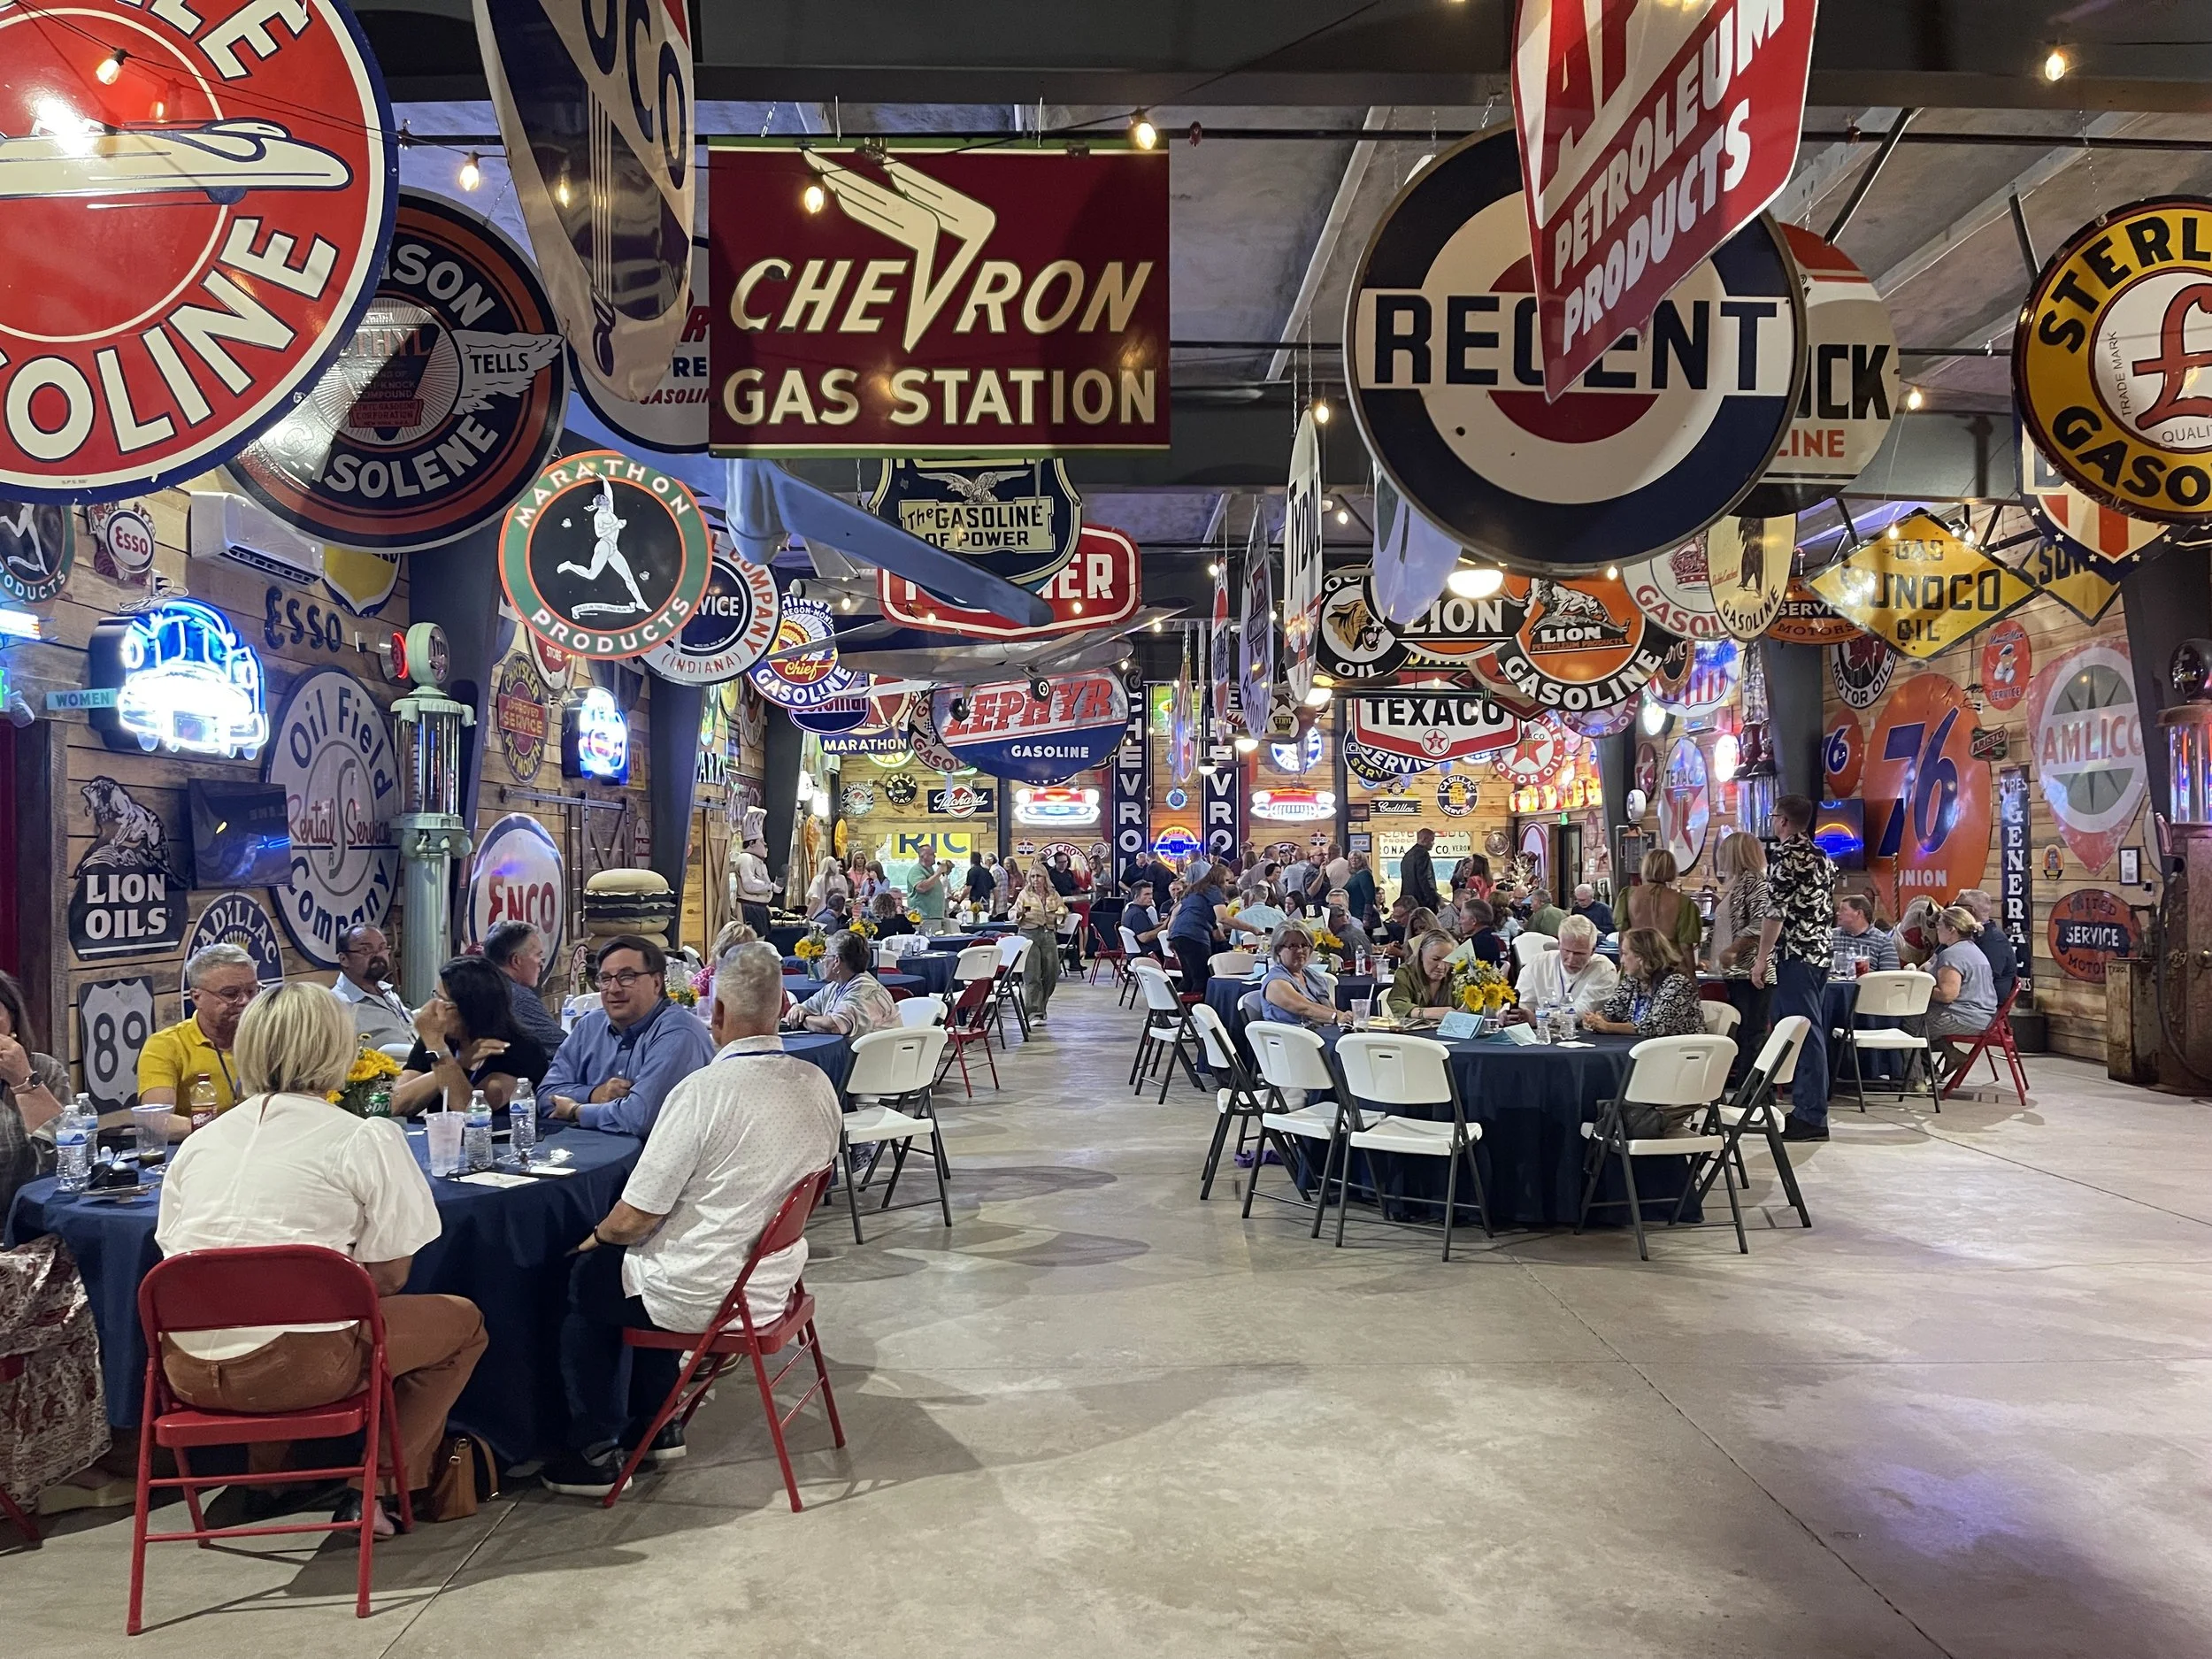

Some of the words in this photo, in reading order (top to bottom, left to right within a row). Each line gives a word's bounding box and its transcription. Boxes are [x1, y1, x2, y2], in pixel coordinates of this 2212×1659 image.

[1555, 0, 1786, 288] PETROLEUM
[1563, 99, 1750, 356] PRODUCTS
[730, 221, 1153, 354] CHEVRON
[2039, 218, 2212, 354] STERL
[0, 218, 337, 462] OLINE
[339, 328, 433, 356] THYL
[2107, 331, 2124, 370] MARK
[470, 352, 529, 373] TELLS
[723, 367, 861, 426] GAS
[889, 367, 1156, 426] STATION
[2116, 372, 2131, 417] TRADE
[513, 457, 691, 530] MARATHON
[907, 508, 934, 531] The
[935, 505, 1043, 529] GASOLINE
[115, 526, 149, 555] ESSO
[925, 532, 950, 547] OF
[956, 531, 1029, 547] POWER
[1288, 471, 1321, 601] TYDOL
[1895, 539, 1945, 562] GAS
[265, 586, 342, 653] ESSO
[1722, 585, 1780, 632] GASOLINE
[531, 597, 691, 654] PRODUCTS
[1541, 626, 1601, 641] LION
[1779, 622, 1856, 637] MOTORS
[1897, 618, 1941, 641] OIL
[546, 644, 563, 663] STORE
[1532, 640, 1579, 650] PETROLEUM
[1581, 637, 1624, 647] PRODUCTS
[661, 651, 742, 675] (INDIANA)
[784, 660, 819, 680] Chief
[1335, 663, 1384, 679] OIL
[504, 660, 541, 701] CHRYSLER
[756, 665, 852, 705] GASOLINE
[1504, 648, 1663, 710] GASOLINE
[1833, 663, 1868, 707] MOTOR
[56, 693, 111, 710] WOMEN
[1991, 687, 2022, 701] SERVICE
[503, 710, 543, 734] SERVICE
[1366, 698, 1504, 726] TEXACO
[1617, 696, 1640, 726] OIL
[290, 687, 327, 769] Oil
[339, 686, 394, 800] Field
[824, 738, 907, 752] MARATHON
[1010, 744, 1089, 758] GASOLINE
[1972, 730, 2004, 752] ARISTO
[505, 736, 541, 778] PLYMOUTH
[697, 752, 727, 786] ARKS
[1492, 752, 1540, 785] MOTOR
[1544, 750, 1564, 777] OIL
[887, 772, 917, 788] POLLY
[1440, 775, 1475, 792] CADILLAC
[1878, 706, 1960, 859] 76
[2001, 777, 2028, 792] TIRES
[933, 791, 989, 811] Packard
[1378, 801, 1416, 813] Cadillac
[1444, 804, 1471, 816] SERVICE
[288, 794, 338, 847] Rental
[345, 797, 393, 846] Service
[1380, 845, 1407, 855] ONA
[1435, 845, 1450, 855] CO.
[86, 873, 167, 904] LION
[488, 869, 557, 934] ENCO
[85, 906, 167, 940] OILS
[2065, 925, 2120, 947] SERVICE
[93, 1010, 148, 1084] 89
